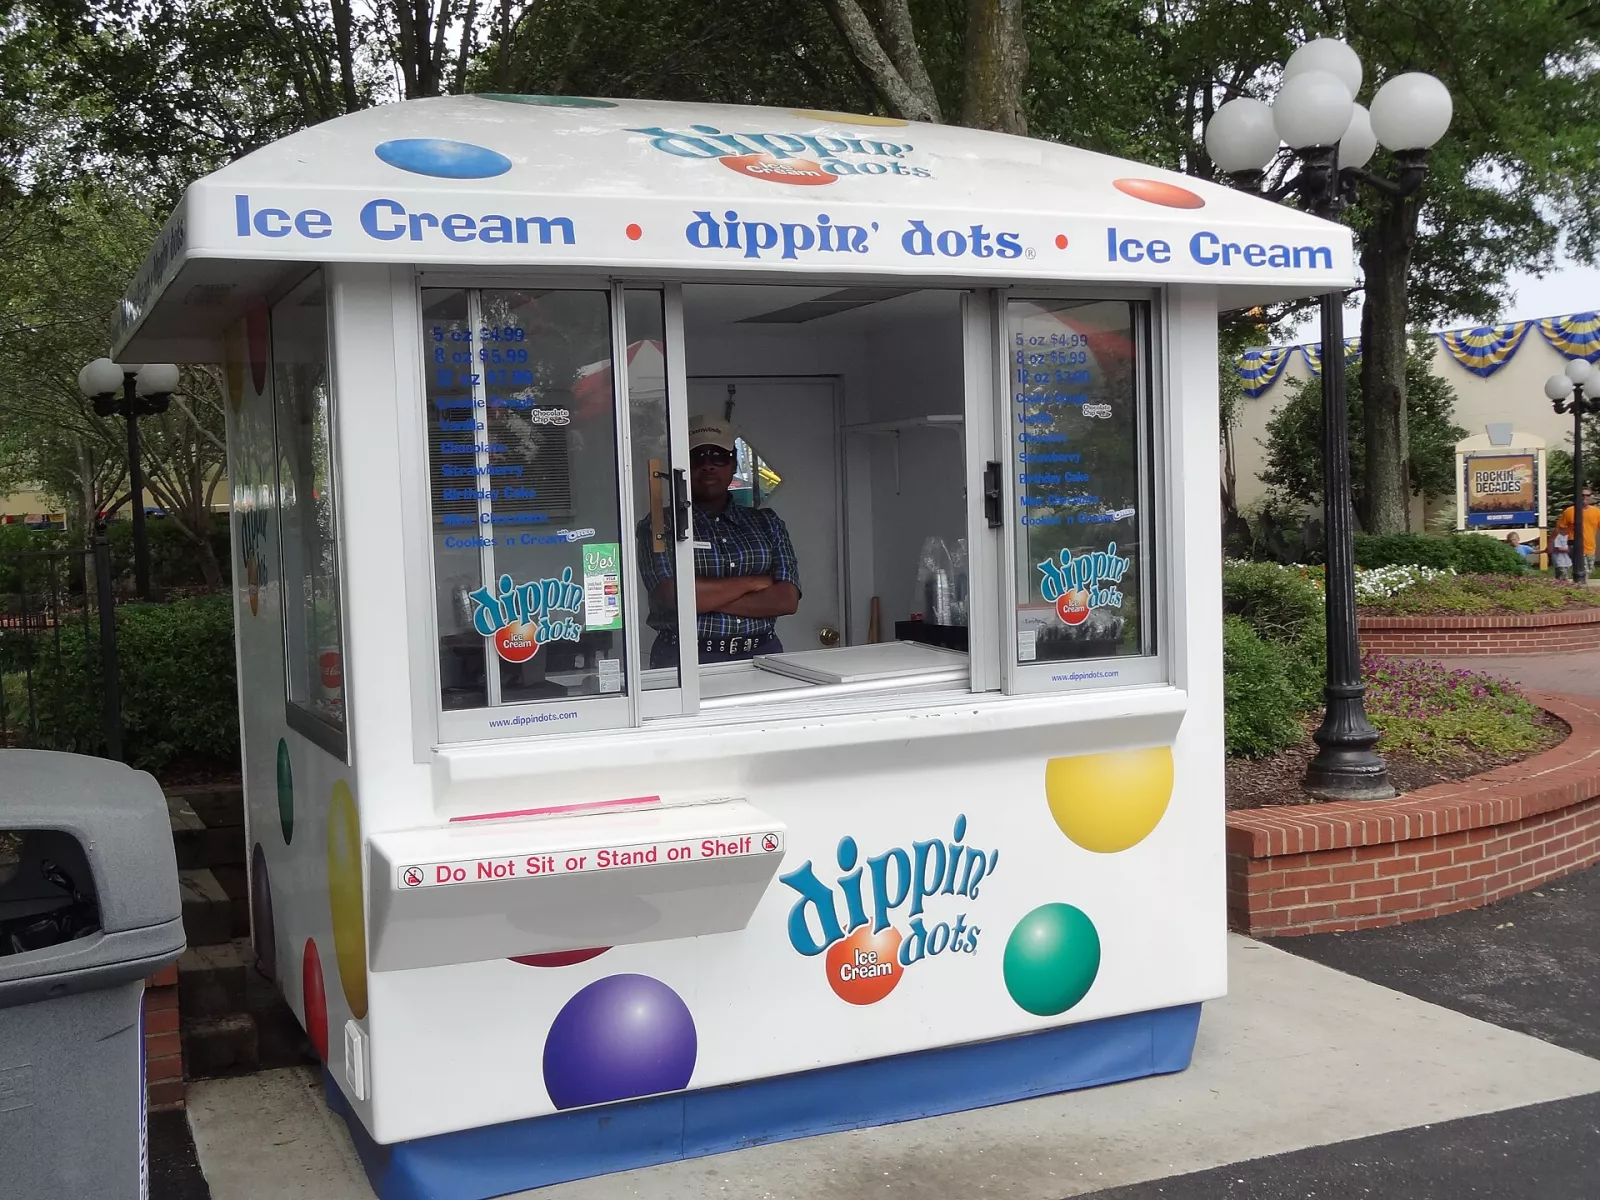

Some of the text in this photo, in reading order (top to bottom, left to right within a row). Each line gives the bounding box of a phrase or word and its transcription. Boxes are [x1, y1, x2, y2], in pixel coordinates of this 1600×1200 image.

[622, 124, 914, 160] dippin'
[745, 164, 822, 177] Cream
[758, 161, 793, 170] Ice
[819, 158, 932, 177] dots
[234, 193, 576, 245] Ice Cream
[685, 210, 880, 260] dippin'
[1107, 227, 1333, 269] Ice Cream
[433, 326, 444, 342] 5
[1015, 333, 1088, 347] 5 oz $4.99
[434, 346, 445, 363] 8
[479, 348, 528, 364] $5.99
[1016, 351, 1087, 365] 8 oz $5.99
[1035, 373, 1049, 383] oz
[532, 408, 569, 417] Chocolate
[1065, 471, 1089, 482] Cake
[1475, 481, 1521, 493] DECADES
[444, 535, 498, 548] Cookies
[520, 532, 568, 546] Cream
[586, 547, 617, 571] Yes!
[1037, 541, 1129, 602] dippin'
[1068, 599, 1080, 607] Ice
[1086, 585, 1123, 608] dots
[1062, 605, 1085, 613] Cream
[510, 632, 524, 641] Ice
[534, 616, 582, 645] dots
[503, 639, 532, 649] Cream
[1051, 671, 1119, 682] www.dippindots.com
[489, 711, 578, 728] www.dippindots.com
[436, 837, 752, 884] Do Not Sit or Stand on Shelf
[778, 813, 999, 957] dippin'
[899, 913, 982, 966] dots
[854, 948, 878, 966] Ice
[840, 961, 893, 981] Cream
